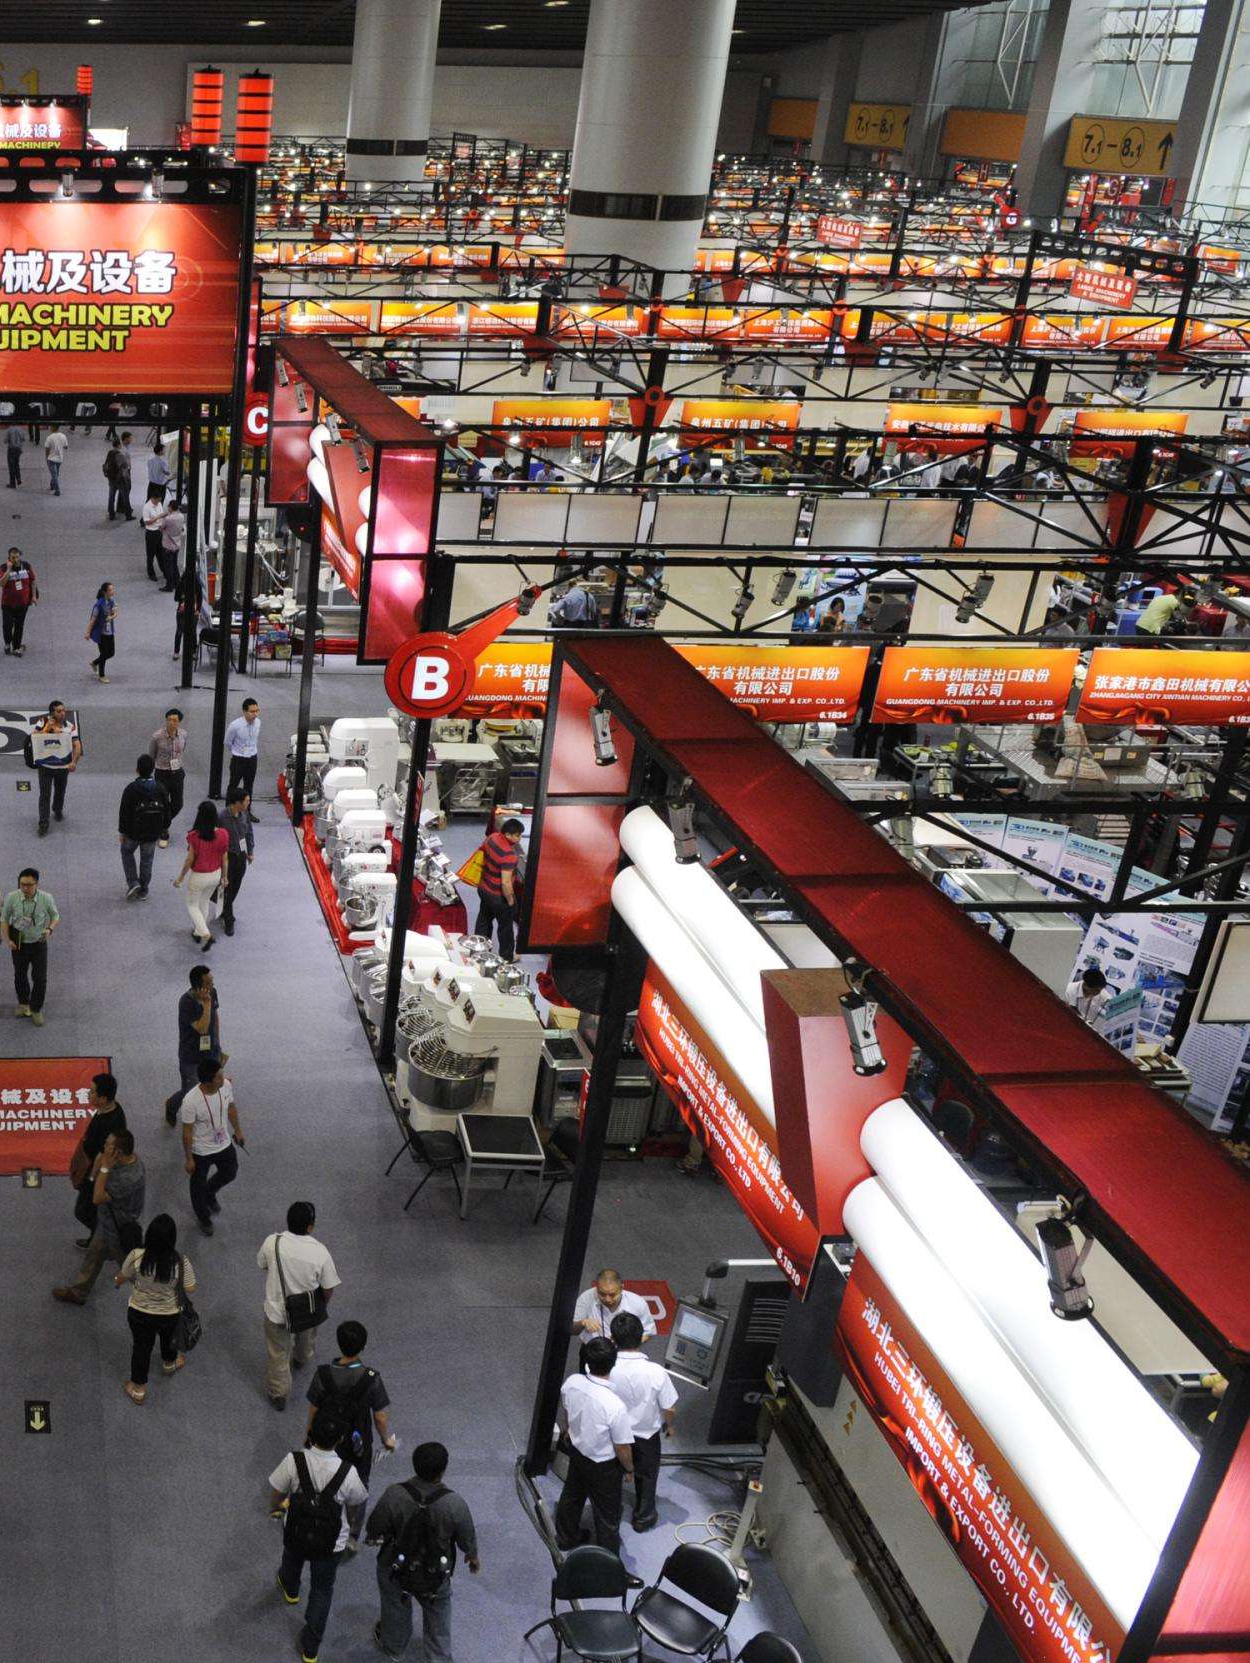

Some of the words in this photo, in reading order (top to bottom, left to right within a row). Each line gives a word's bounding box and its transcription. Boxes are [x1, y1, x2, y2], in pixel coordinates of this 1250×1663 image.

[248, 406, 269, 434] C
[411, 656, 450, 701] B
[734, 681, 793, 696] 有限公司
[903, 667, 1050, 683] 广东省机械进出口股份
[466, 694, 513, 702] UANGDONG
[886, 698, 936, 706] GUANGDONG
[944, 682, 1004, 698] 有限公司
[1191, 694, 1231, 702] MACHINERY
[658, 1029, 675, 1054] HUBEI
[746, 1156, 786, 1215] EQUIPMENT
[677, 1073, 699, 1111] IMPORT
[704, 1115, 727, 1147] EXPORT
[776, 1246, 801, 1288] 6.1B10
[873, 1351, 902, 1397] HUBEI
[1028, 1587, 1082, 1663] EQUIPME
[904, 1426, 941, 1483] IMPORT
[940, 1483, 950, 1499] &
[950, 1497, 990, 1559] EXPORT
[1011, 1595, 1037, 1636] LTD.
